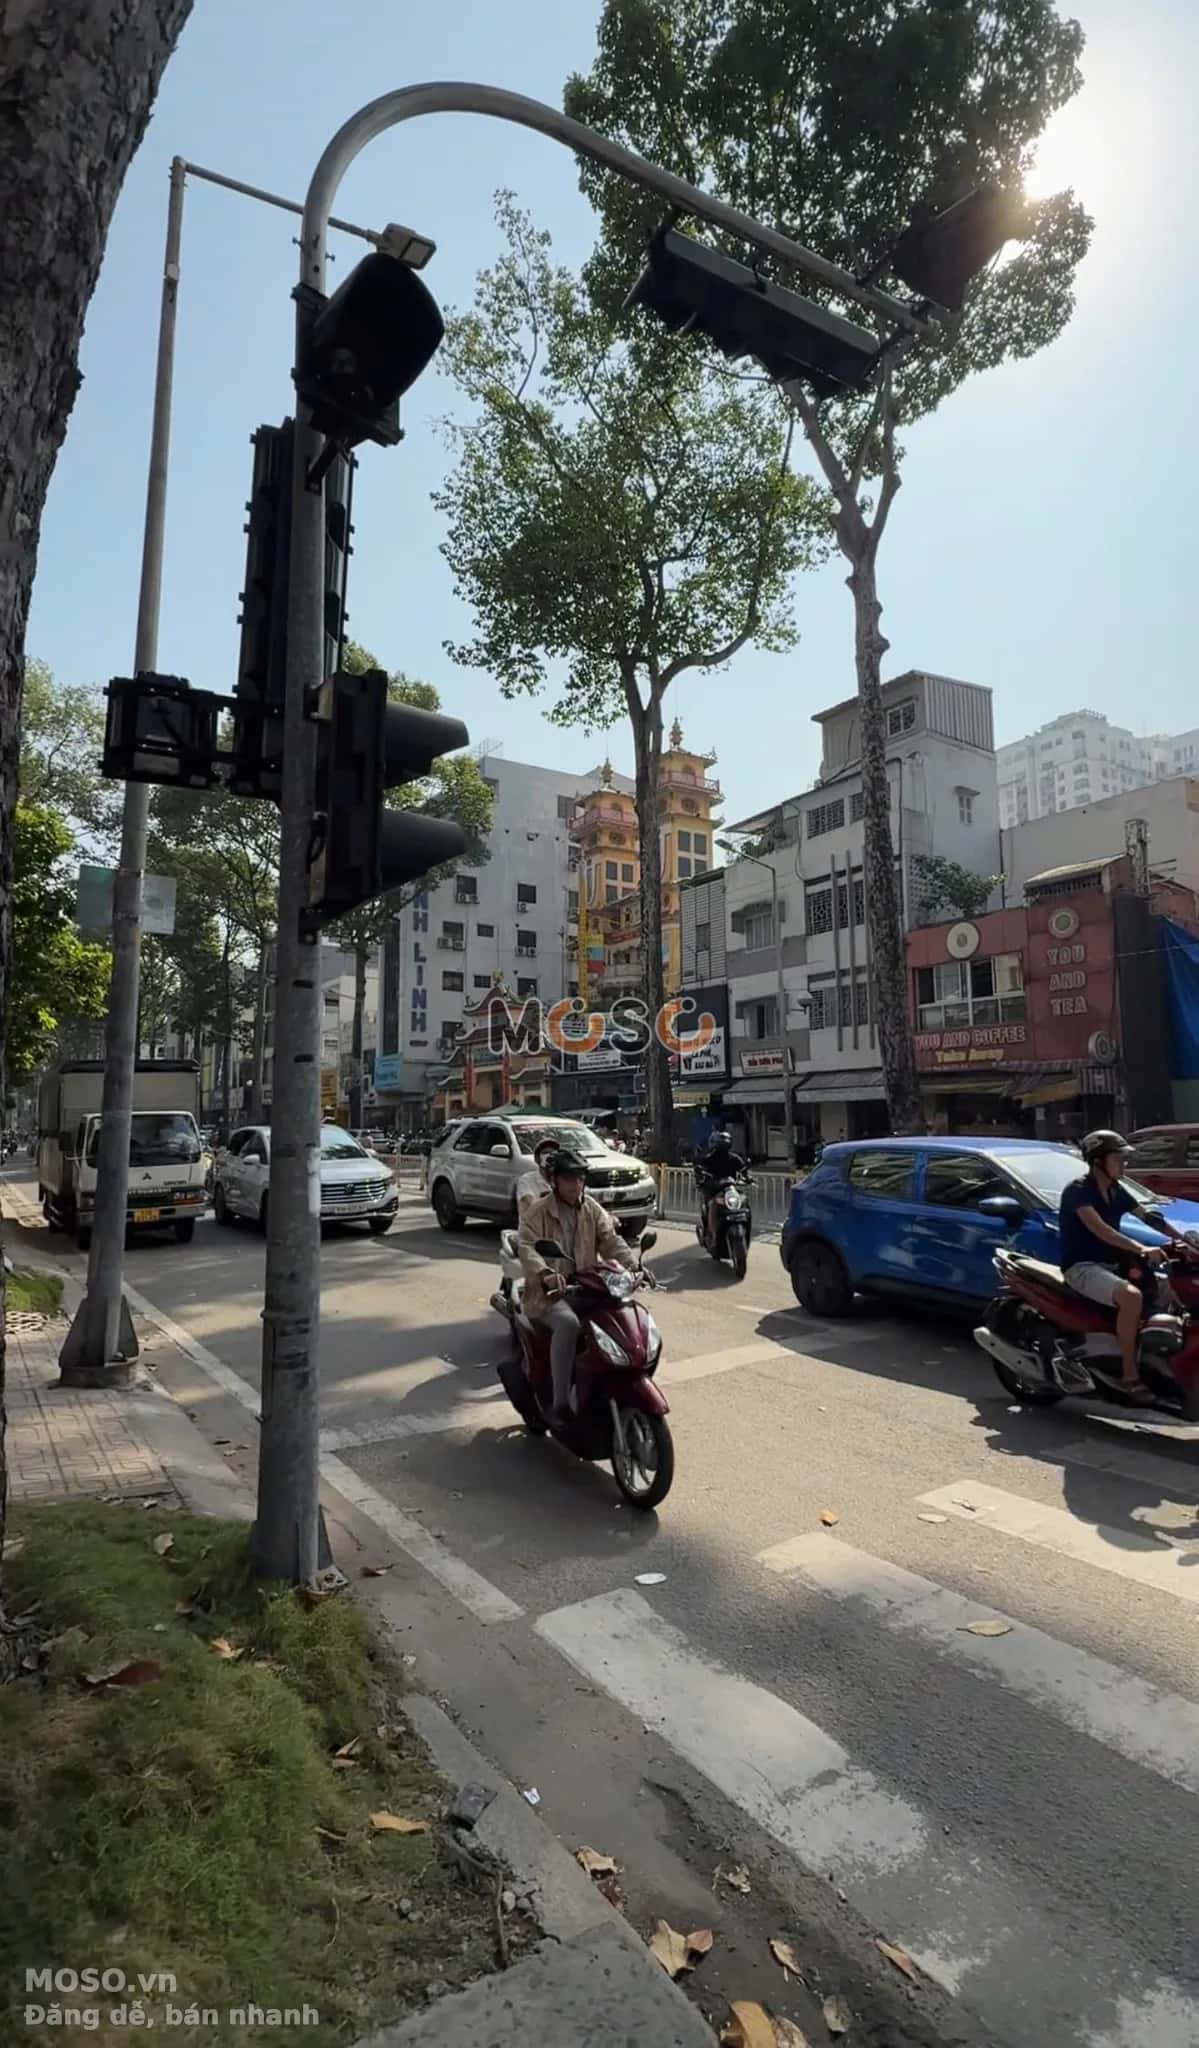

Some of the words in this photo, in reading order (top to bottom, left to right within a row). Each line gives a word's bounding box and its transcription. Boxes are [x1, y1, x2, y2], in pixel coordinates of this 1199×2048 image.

[1047, 943, 1086, 965] YOU
[411, 942, 429, 1033] LINH
[1049, 970, 1087, 991] AND
[1050, 995, 1088, 1016] TEA
[942, 1031, 970, 1048] AND
[972, 1025, 1025, 1046] COFFEE
